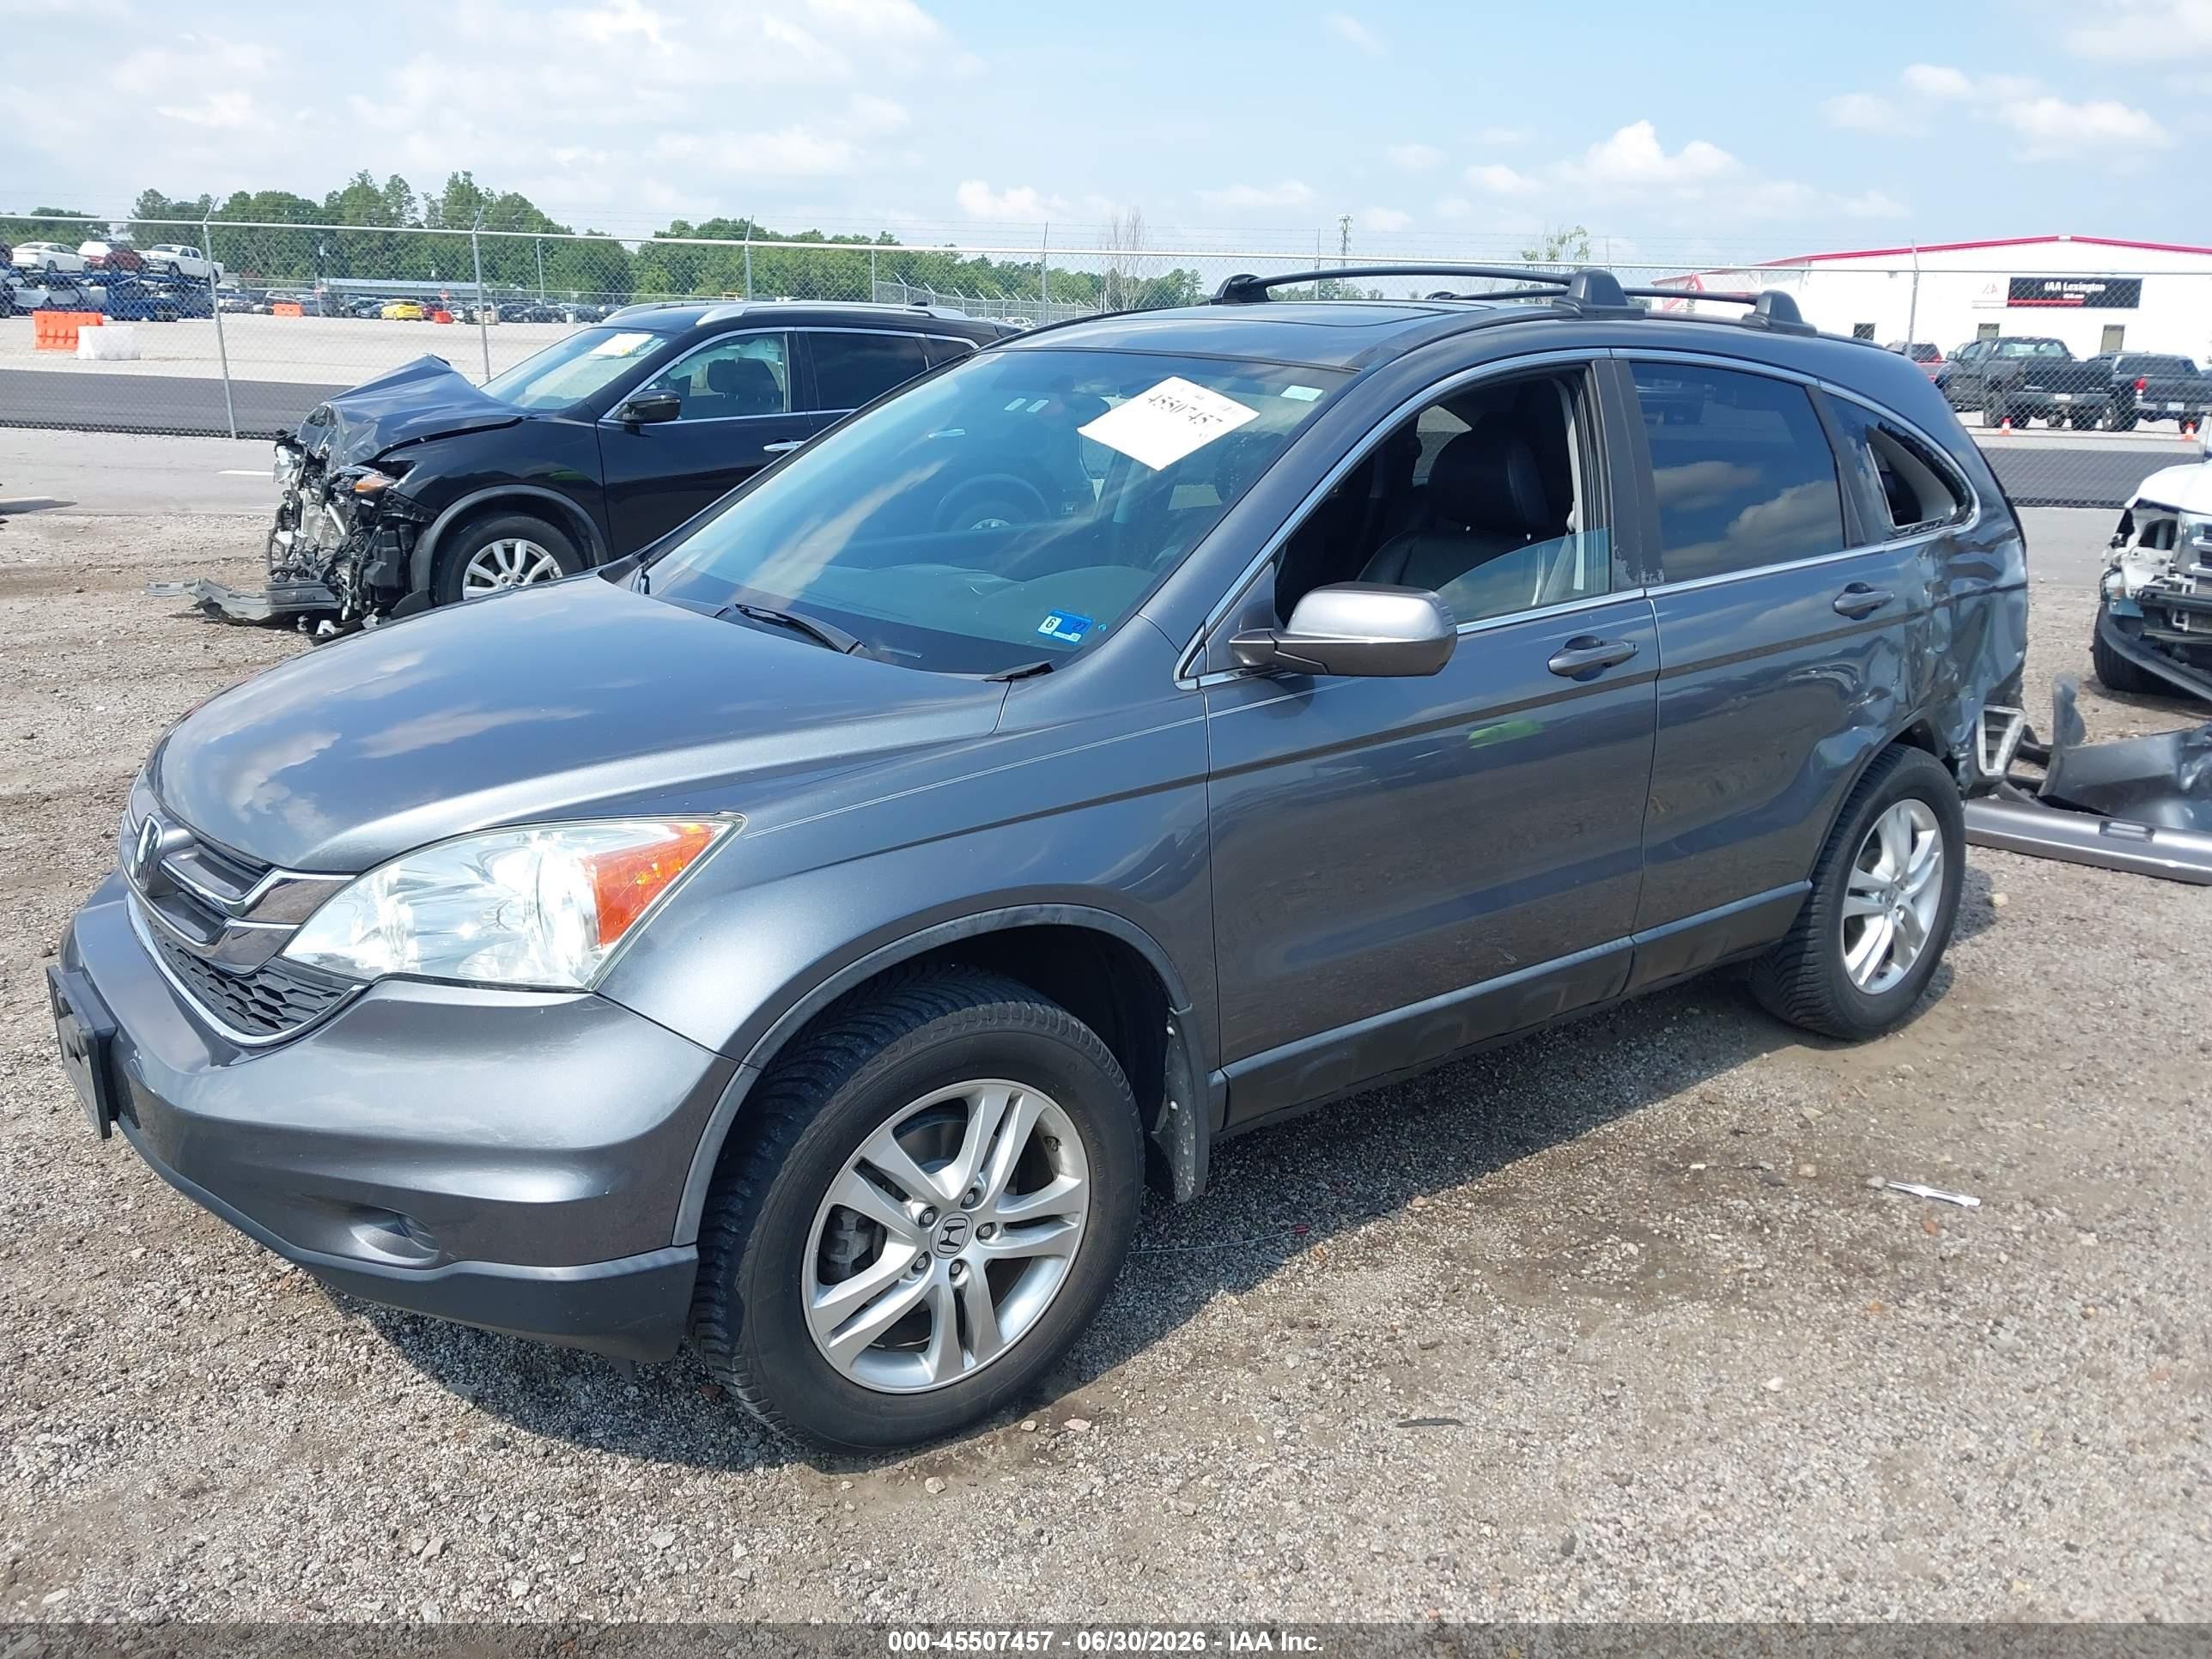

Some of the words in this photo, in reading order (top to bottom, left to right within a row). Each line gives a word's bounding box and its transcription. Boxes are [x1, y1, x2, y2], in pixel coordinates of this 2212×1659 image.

[2045, 282, 2062, 291] IAA
[2063, 282, 2106, 293] Lexington
[1045, 617, 1057, 629] 6
